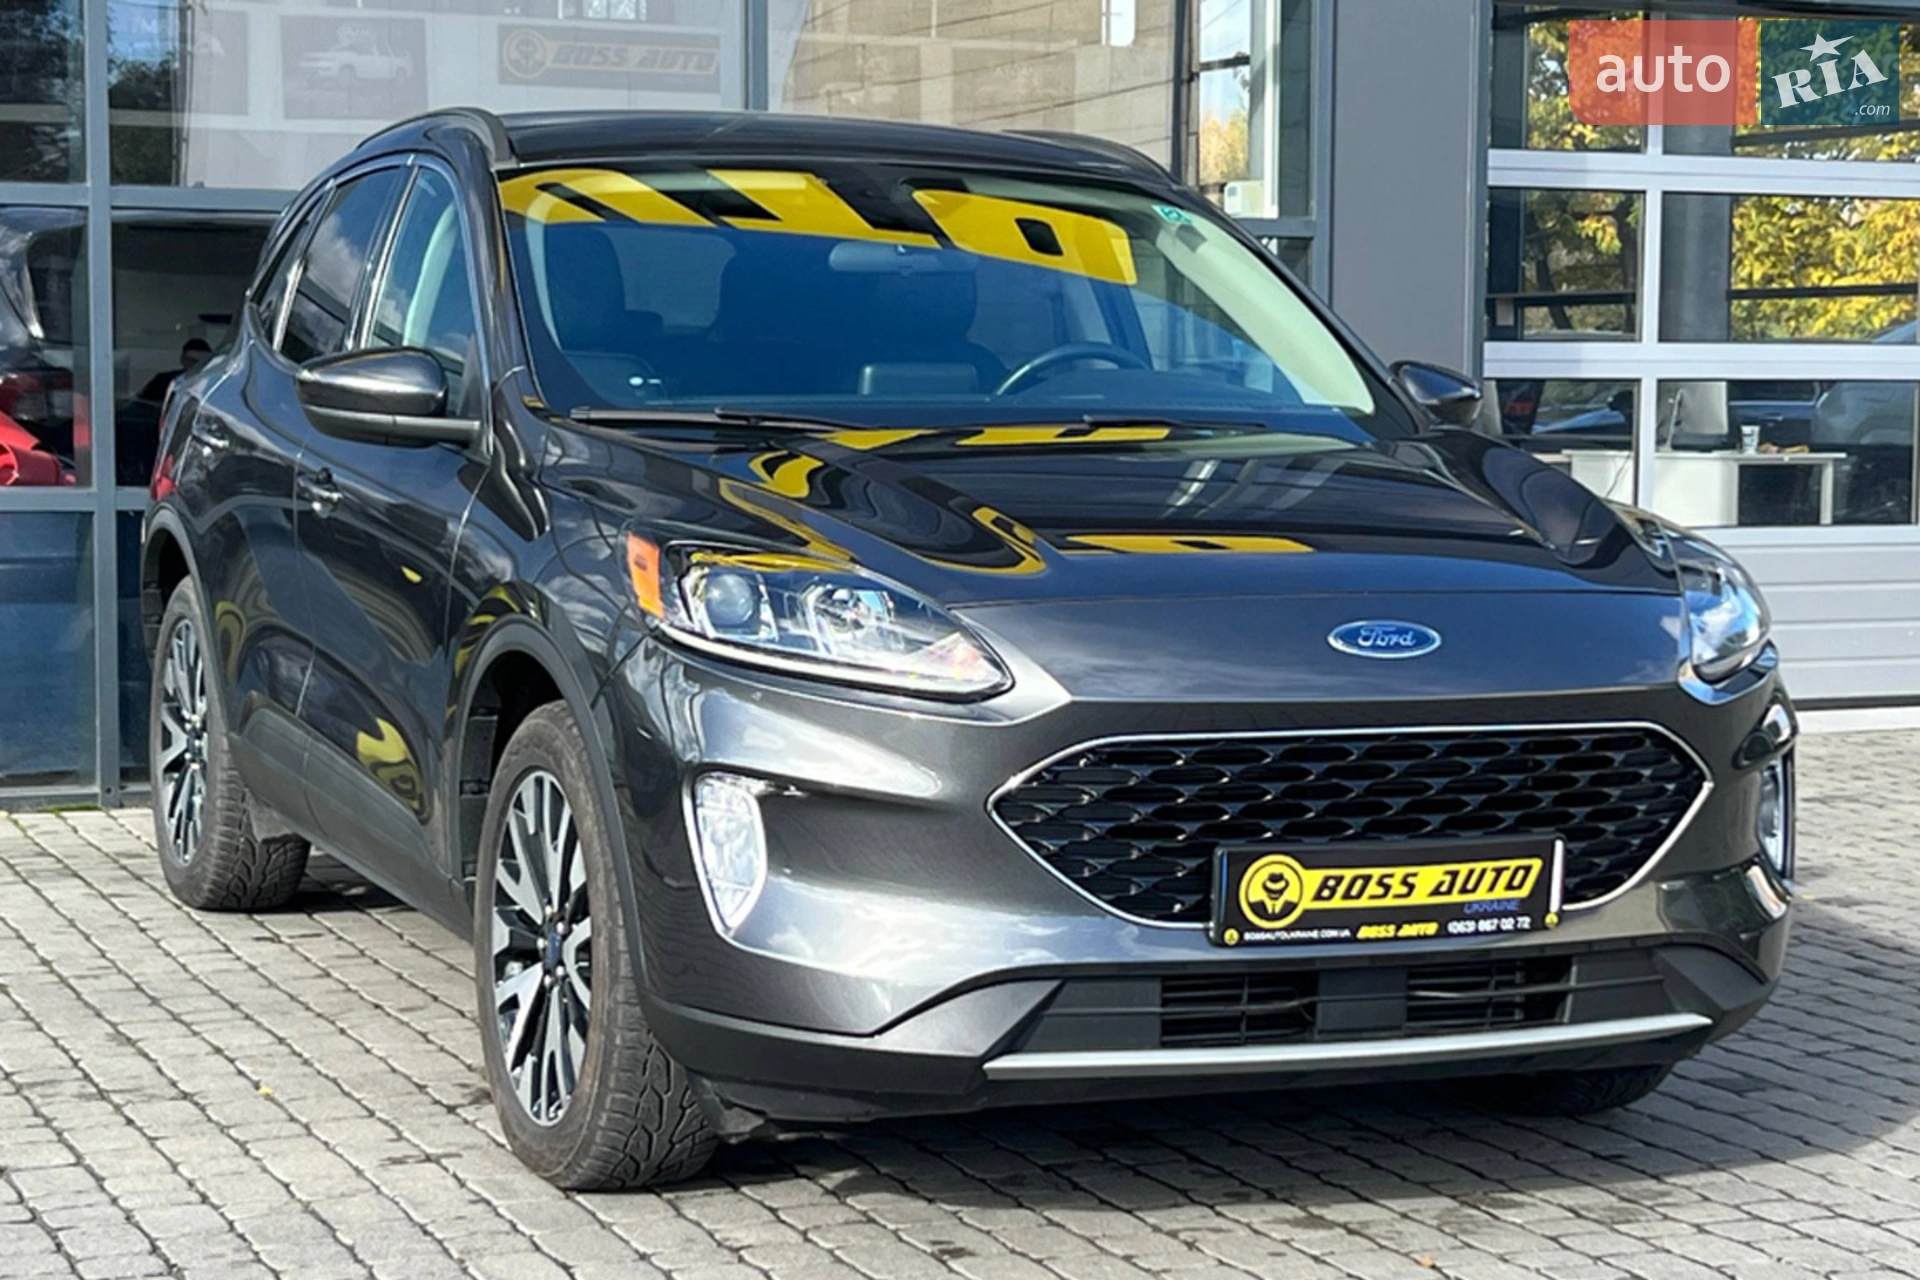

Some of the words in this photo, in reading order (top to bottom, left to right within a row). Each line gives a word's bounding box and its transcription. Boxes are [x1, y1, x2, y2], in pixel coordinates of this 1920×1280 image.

[555, 46, 631, 68] BOSS
[636, 49, 715, 72] AUTO
[1357, 626, 1417, 647] Ford
[1312, 872, 1418, 901] BOSS
[1429, 864, 1534, 897] AUTO
[1463, 899, 1522, 914] UKRAINE
